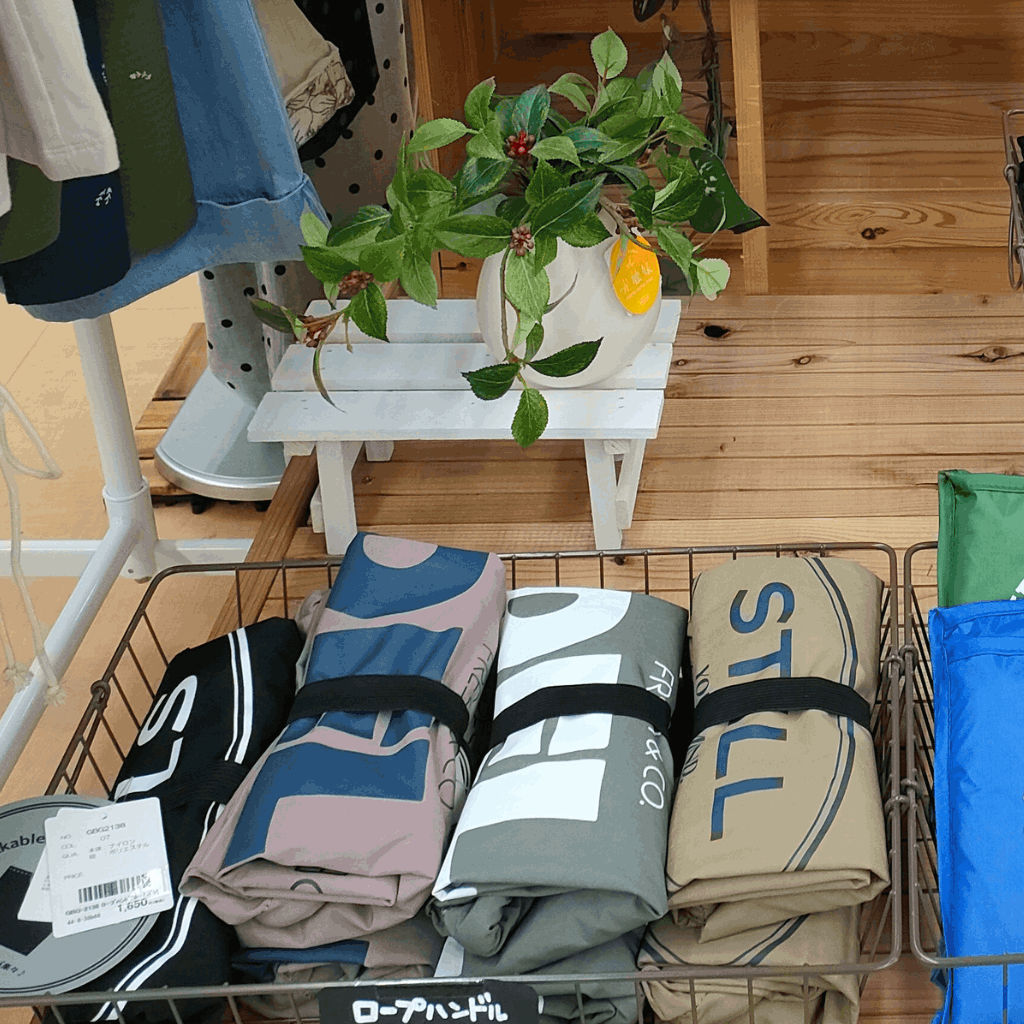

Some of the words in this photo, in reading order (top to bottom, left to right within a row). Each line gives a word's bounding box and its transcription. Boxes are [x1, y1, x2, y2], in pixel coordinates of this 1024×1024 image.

[710, 581, 795, 842] STLL
[639, 766, 666, 810] CO.
[0, 833, 46, 853] kable
[117, 898, 148, 913] 1,650
[352, 991, 509, 1024] ロープハンドル
